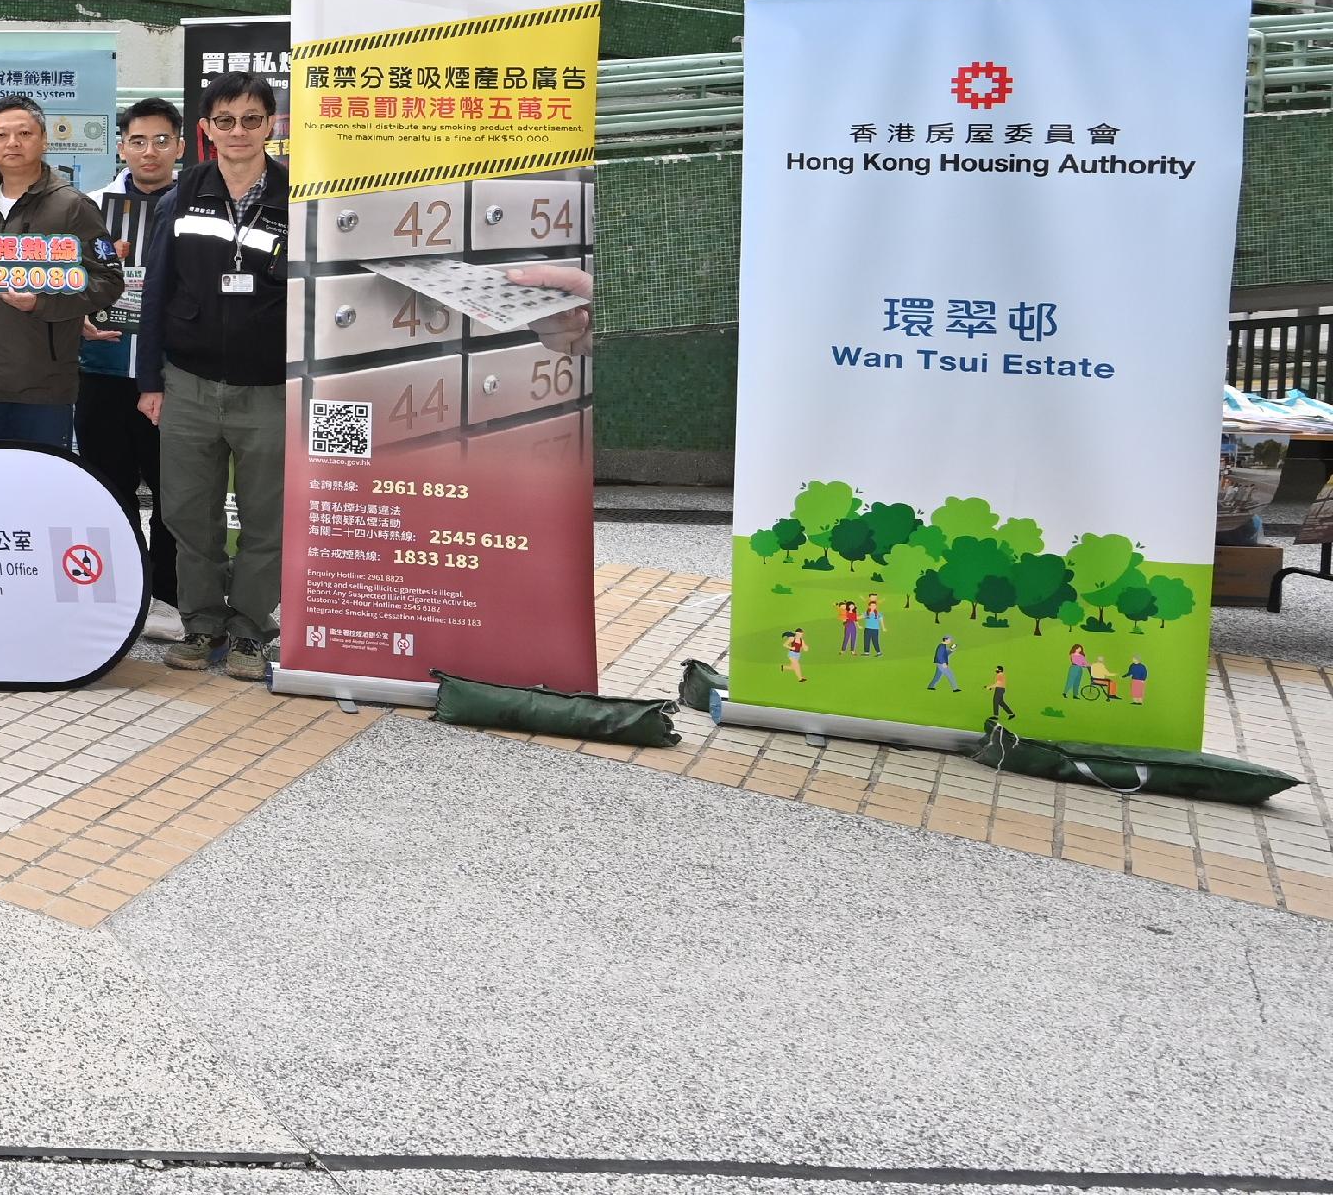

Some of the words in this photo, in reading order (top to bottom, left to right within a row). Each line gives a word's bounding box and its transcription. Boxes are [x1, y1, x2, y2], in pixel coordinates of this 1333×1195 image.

[305, 66, 586, 90] 嚴禁分發吸煙產品廣告
[0, 89, 33, 99] Stamp
[36, 89, 75, 100] System
[319, 96, 572, 121] 最高罰款港幣五萬元
[337, 133, 353, 141] The
[355, 134, 395, 142] maximum
[398, 134, 431, 143] penalty
[352, 122, 372, 130] shall
[376, 123, 419, 131] distribute
[422, 124, 437, 133] any
[440, 123, 477, 133] smoking
[480, 123, 514, 132] product
[849, 122, 1121, 146] 香港房屋委員會
[786, 152, 854, 174] Hong
[863, 152, 930, 175] Kong
[939, 152, 1049, 177] Housing
[1057, 154, 1196, 180] Authority
[393, 200, 452, 248] 42
[530, 198, 574, 240] 54
[883, 297, 1058, 342] 環翠邨
[832, 345, 903, 370] Wan
[916, 349, 989, 374] Tsui
[1003, 353, 1116, 380] Estate
[530, 356, 574, 401] 56
[389, 378, 449, 430] 44
[308, 457, 371, 467] www.taco.gov.hk
[372, 479, 417, 495] 2961
[422, 483, 469, 499] 8823
[309, 500, 401, 516] 買賣私煙均屬違法
[309, 512, 401, 528] 舉報懷疑私煙活動
[429, 529, 476, 546] 2545
[481, 533, 529, 550] 6182
[7, 562, 39, 577] Office
[393, 549, 439, 566] 1833
[444, 553, 479, 570] 183
[307, 568, 336, 579] Enquiry
[336, 571, 366, 580] Hotline:
[367, 573, 384, 581] 2961
[385, 575, 404, 583] 8823
[307, 580, 333, 589] Buying
[334, 581, 348, 589] and
[349, 582, 373, 593] selling
[374, 584, 393, 592] illicit
[393, 586, 431, 596] cigarettes
[439, 588, 464, 598] illegal.
[306, 606, 343, 616] Integrated
[345, 608, 378, 619] Smoking
[467, 619, 482, 627] 183
